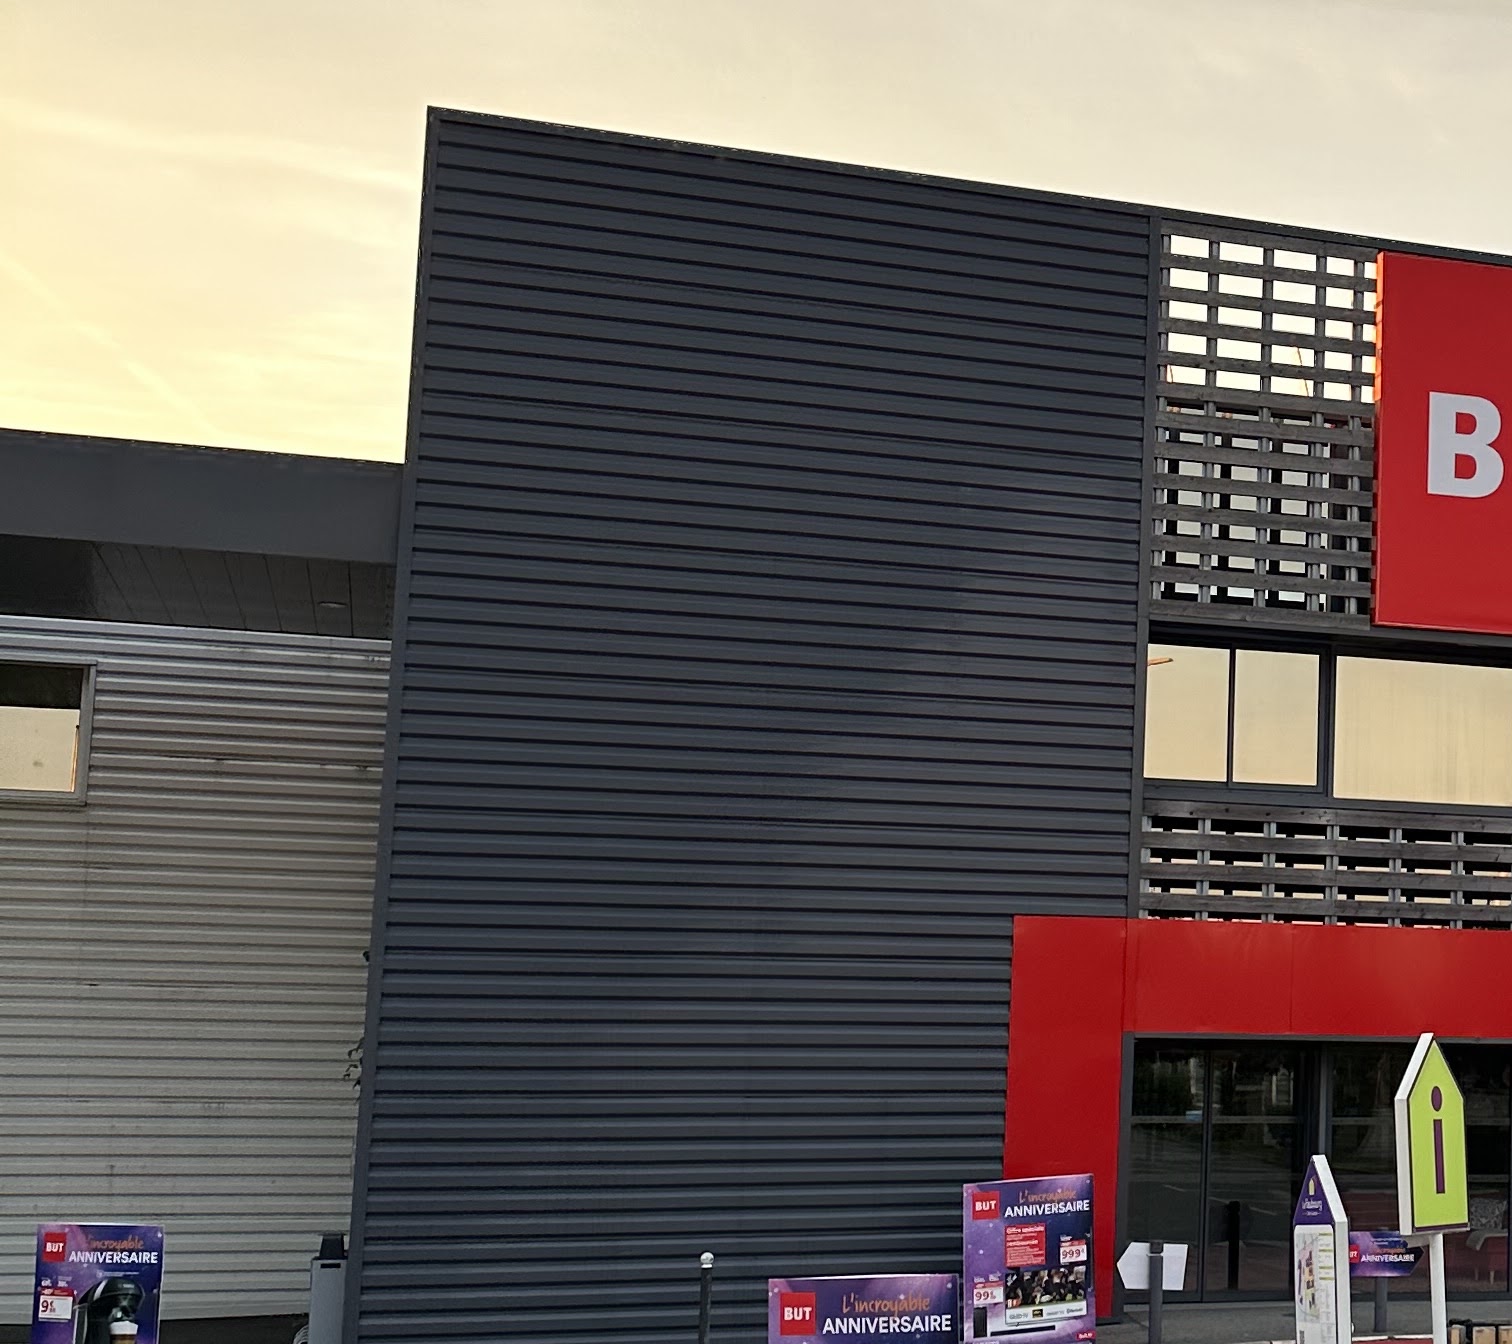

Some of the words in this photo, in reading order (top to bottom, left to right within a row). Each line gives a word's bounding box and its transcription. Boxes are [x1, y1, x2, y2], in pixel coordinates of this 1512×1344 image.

[975, 1201, 997, 1212] BUT
[1004, 1199, 1090, 1218] ANNIVERSAIRE
[45, 1242, 64, 1252] BUT
[68, 1251, 158, 1264] ANNIVERSAIRE
[842, 1291, 930, 1318] L'incroyable
[784, 1307, 812, 1321] BUT
[822, 1314, 952, 1335] ANNIVERSAIRE
